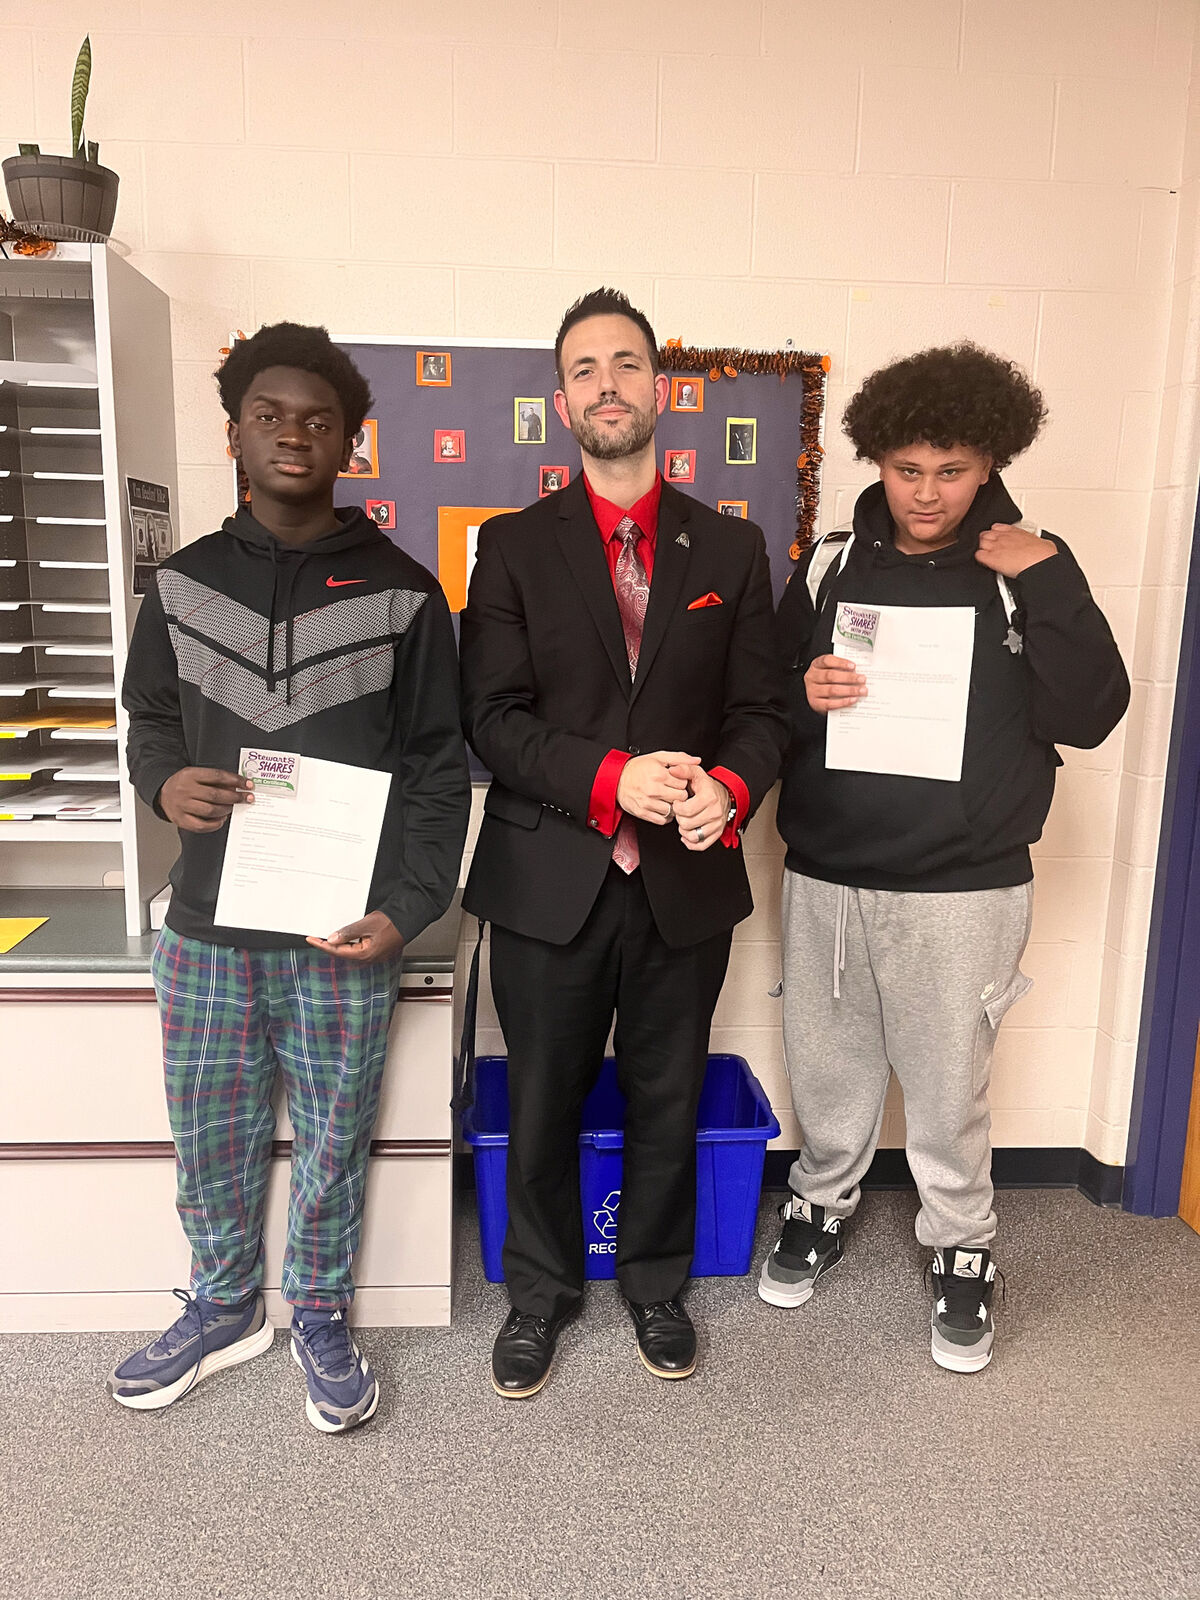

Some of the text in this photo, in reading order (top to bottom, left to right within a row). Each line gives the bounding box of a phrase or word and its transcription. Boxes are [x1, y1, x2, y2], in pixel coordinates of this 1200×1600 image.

[850, 616, 876, 630] SHARES
[258, 760, 295, 774] SHARES
[260, 771, 275, 779] WITH
[588, 1242, 617, 1255] REC
